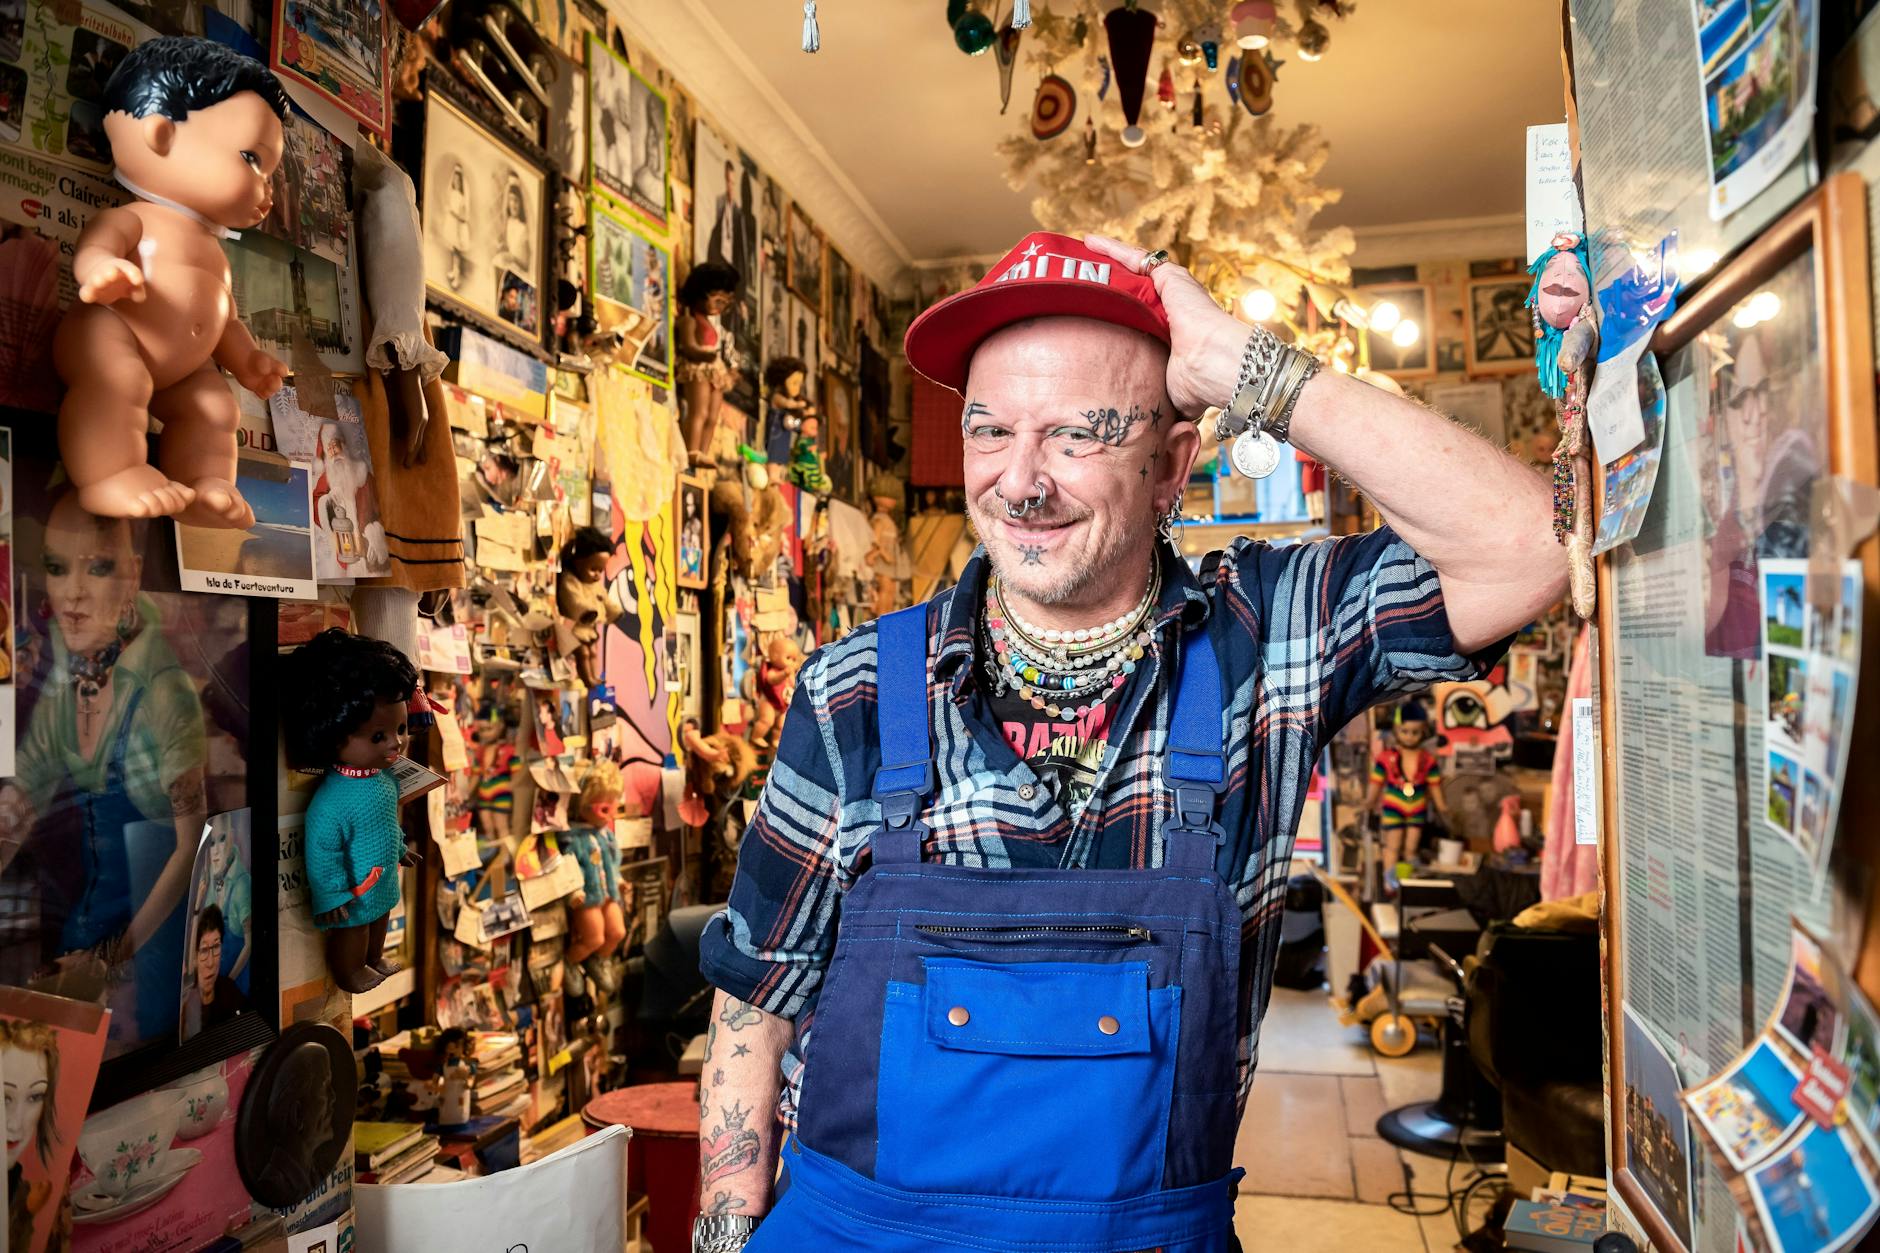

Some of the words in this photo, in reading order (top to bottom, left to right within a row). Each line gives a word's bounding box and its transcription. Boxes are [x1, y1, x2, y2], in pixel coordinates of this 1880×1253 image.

[58, 208, 78, 229] als
[206, 577, 220, 588] Isla
[222, 579, 233, 589] de
[234, 579, 295, 593] Fuerteventura
